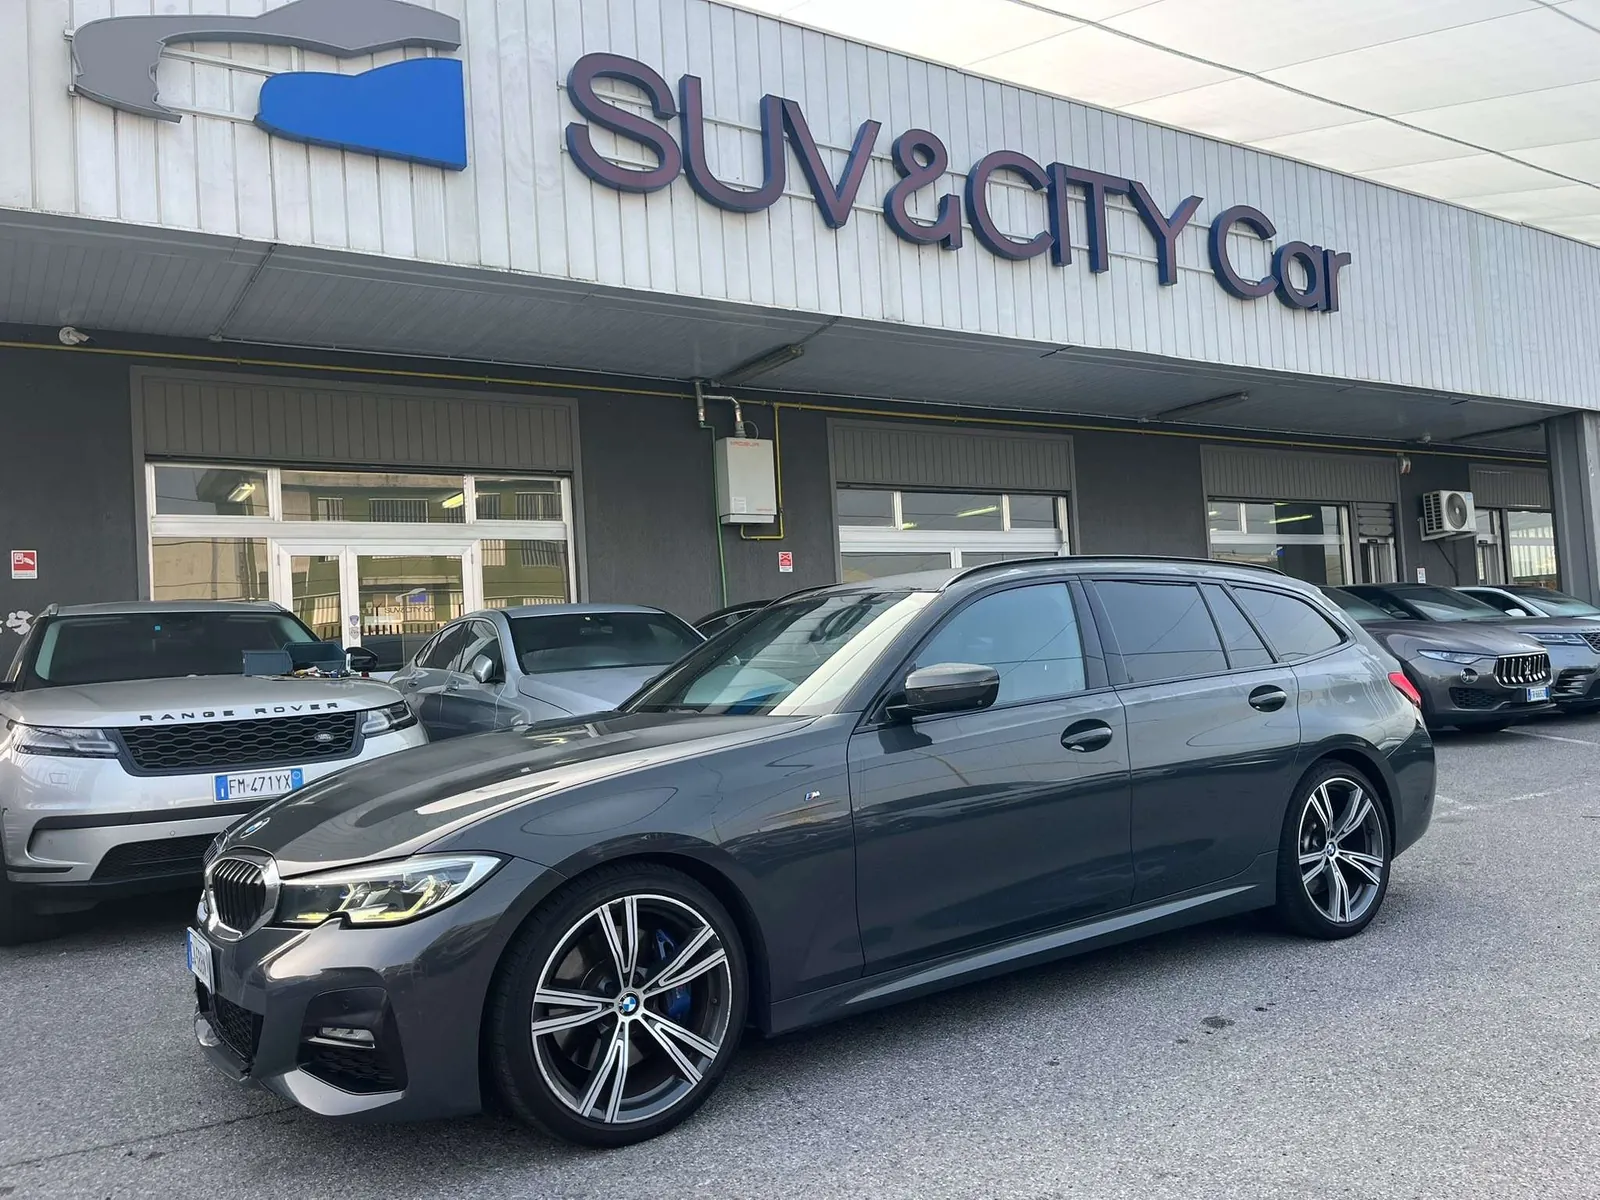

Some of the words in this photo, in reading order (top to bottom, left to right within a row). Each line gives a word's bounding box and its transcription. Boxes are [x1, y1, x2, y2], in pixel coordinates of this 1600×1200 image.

[565, 52, 1204, 286] SUV&CITY
[1208, 204, 1352, 313] Car
[139, 709, 235, 722] RANGE
[254, 702, 339, 714] ROVER
[228, 779, 246, 795] FM
[250, 774, 291, 792] 471YX
